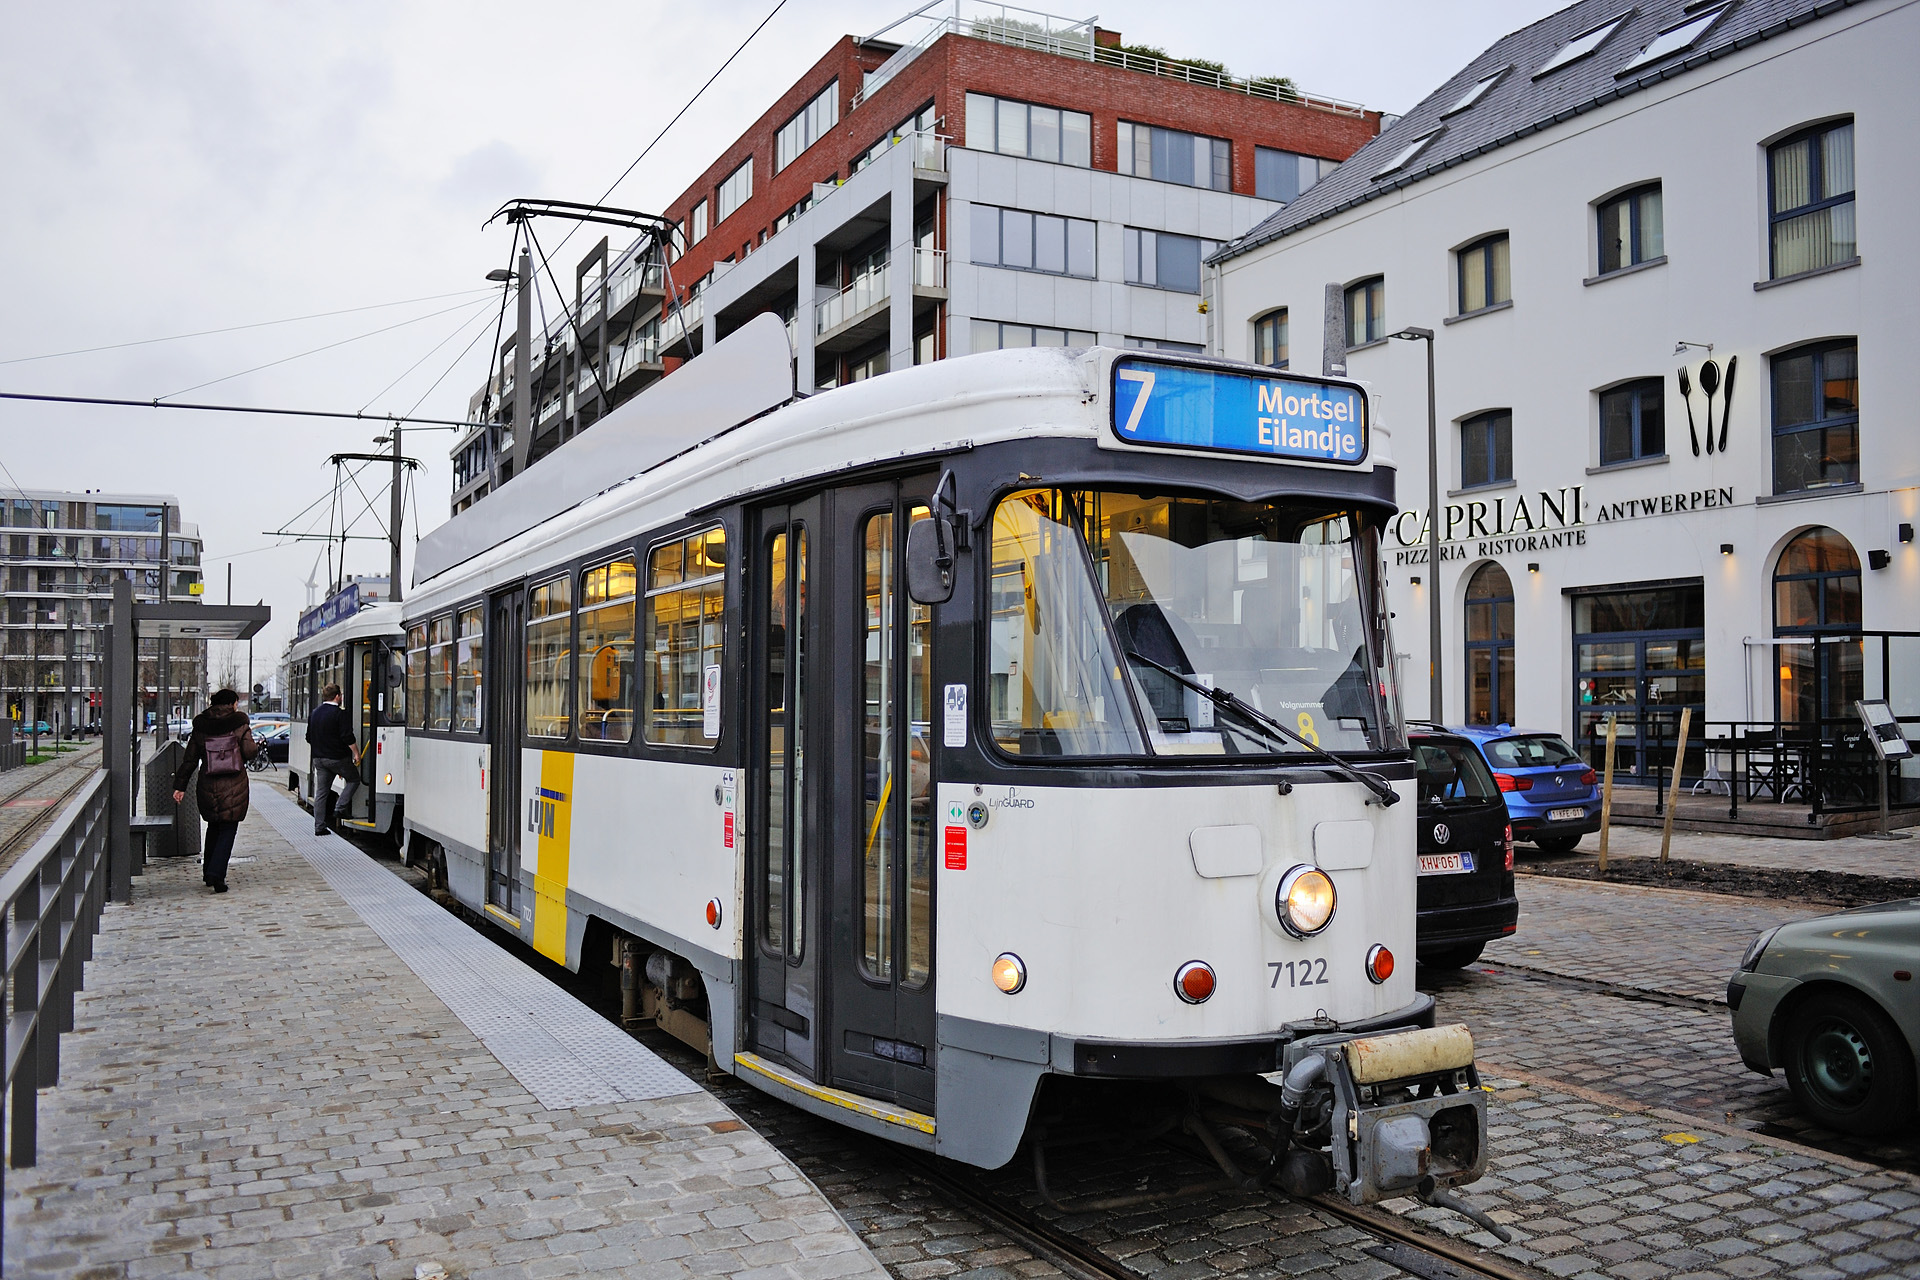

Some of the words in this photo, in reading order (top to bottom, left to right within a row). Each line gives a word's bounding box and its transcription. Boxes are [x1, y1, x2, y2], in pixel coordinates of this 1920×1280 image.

[1119, 369, 1156, 432] 7
[1258, 385, 1354, 422] Mortsel
[1258, 417, 1356, 458] Eilandje
[1597, 486, 1735, 523] ANTWERPEN
[1396, 544, 1466, 566] PIZZRIA
[1478, 530, 1587, 556] RISTORANTE
[1279, 701, 1325, 711] Volgnummer
[1297, 712, 1320, 752] 8
[528, 798, 556, 839] LIJN
[1267, 957, 1329, 989] 7122
